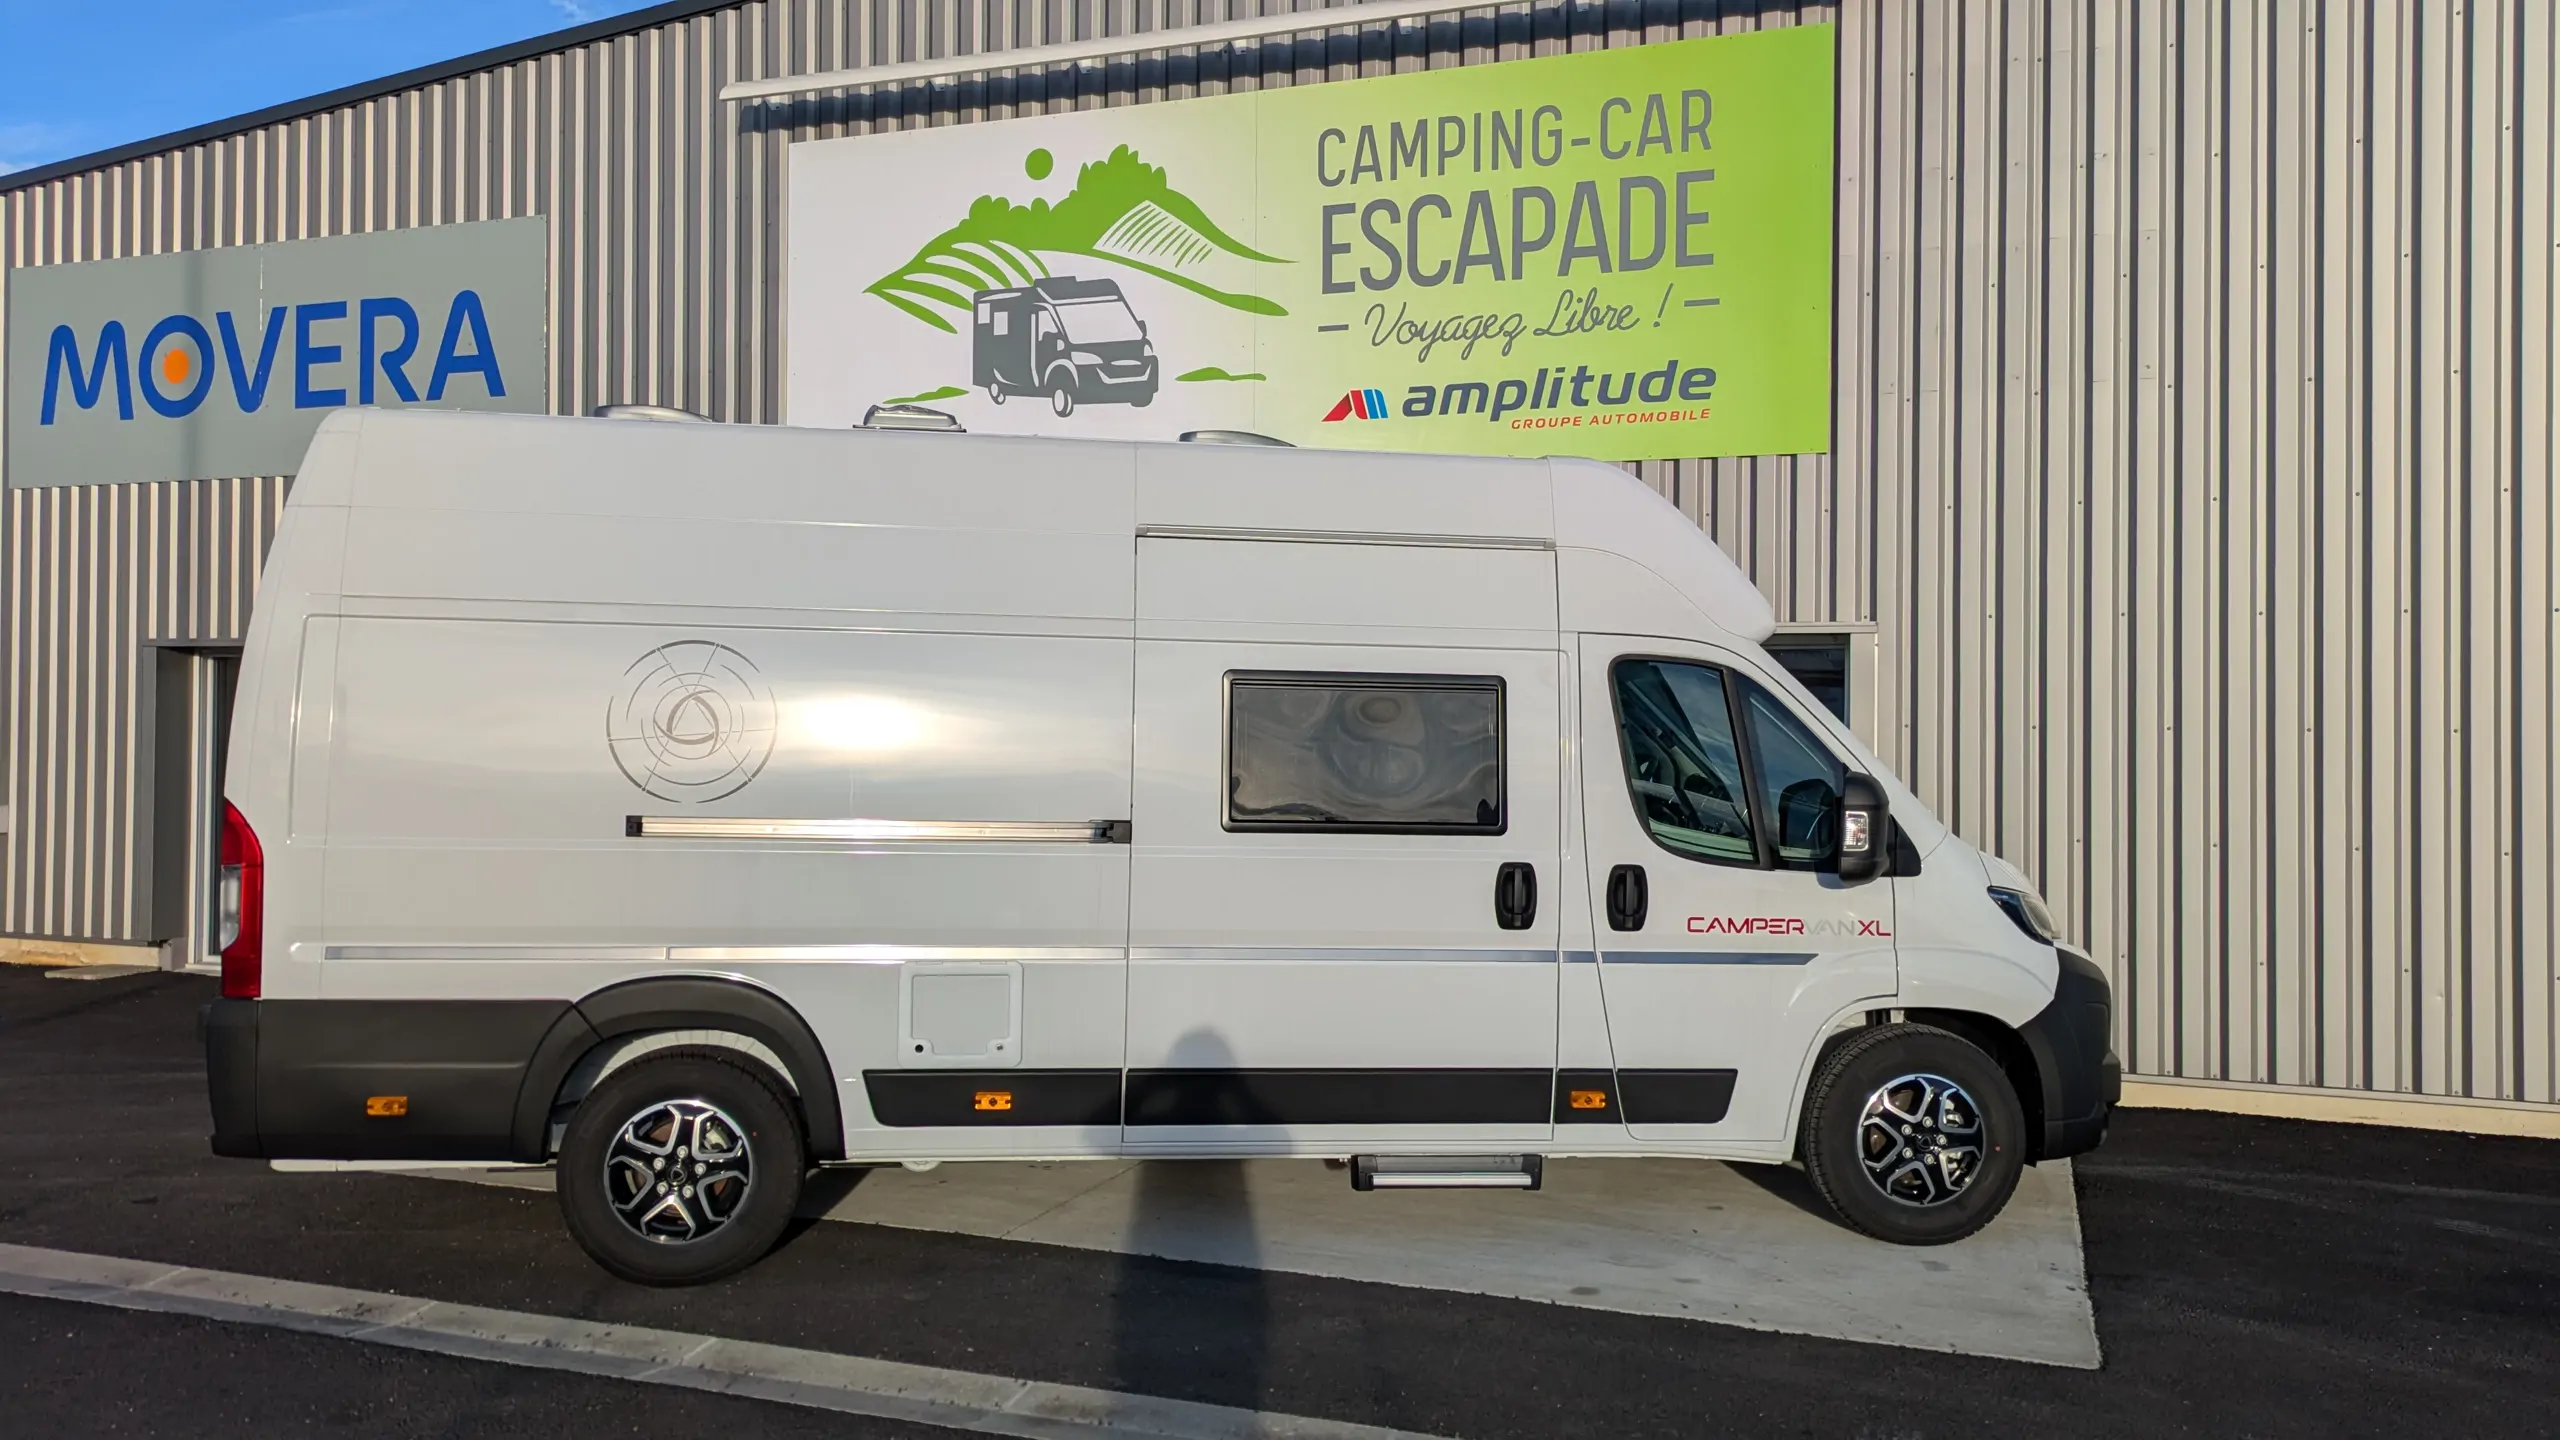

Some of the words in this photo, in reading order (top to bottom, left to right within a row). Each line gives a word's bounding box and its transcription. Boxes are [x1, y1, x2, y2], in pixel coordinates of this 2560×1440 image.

[1317, 89, 1713, 188] CAMPING-CAR
[1321, 168, 1716, 295] ESCAPADE
[40, 289, 507, 426] MOVERA
[1364, 302, 1527, 363] Voyagez
[1533, 287, 1640, 337] Libre
[1402, 359, 1717, 422] amplitude
[1511, 416, 1583, 430] GROUPE
[1588, 408, 1711, 426] AUTOMOBILE
